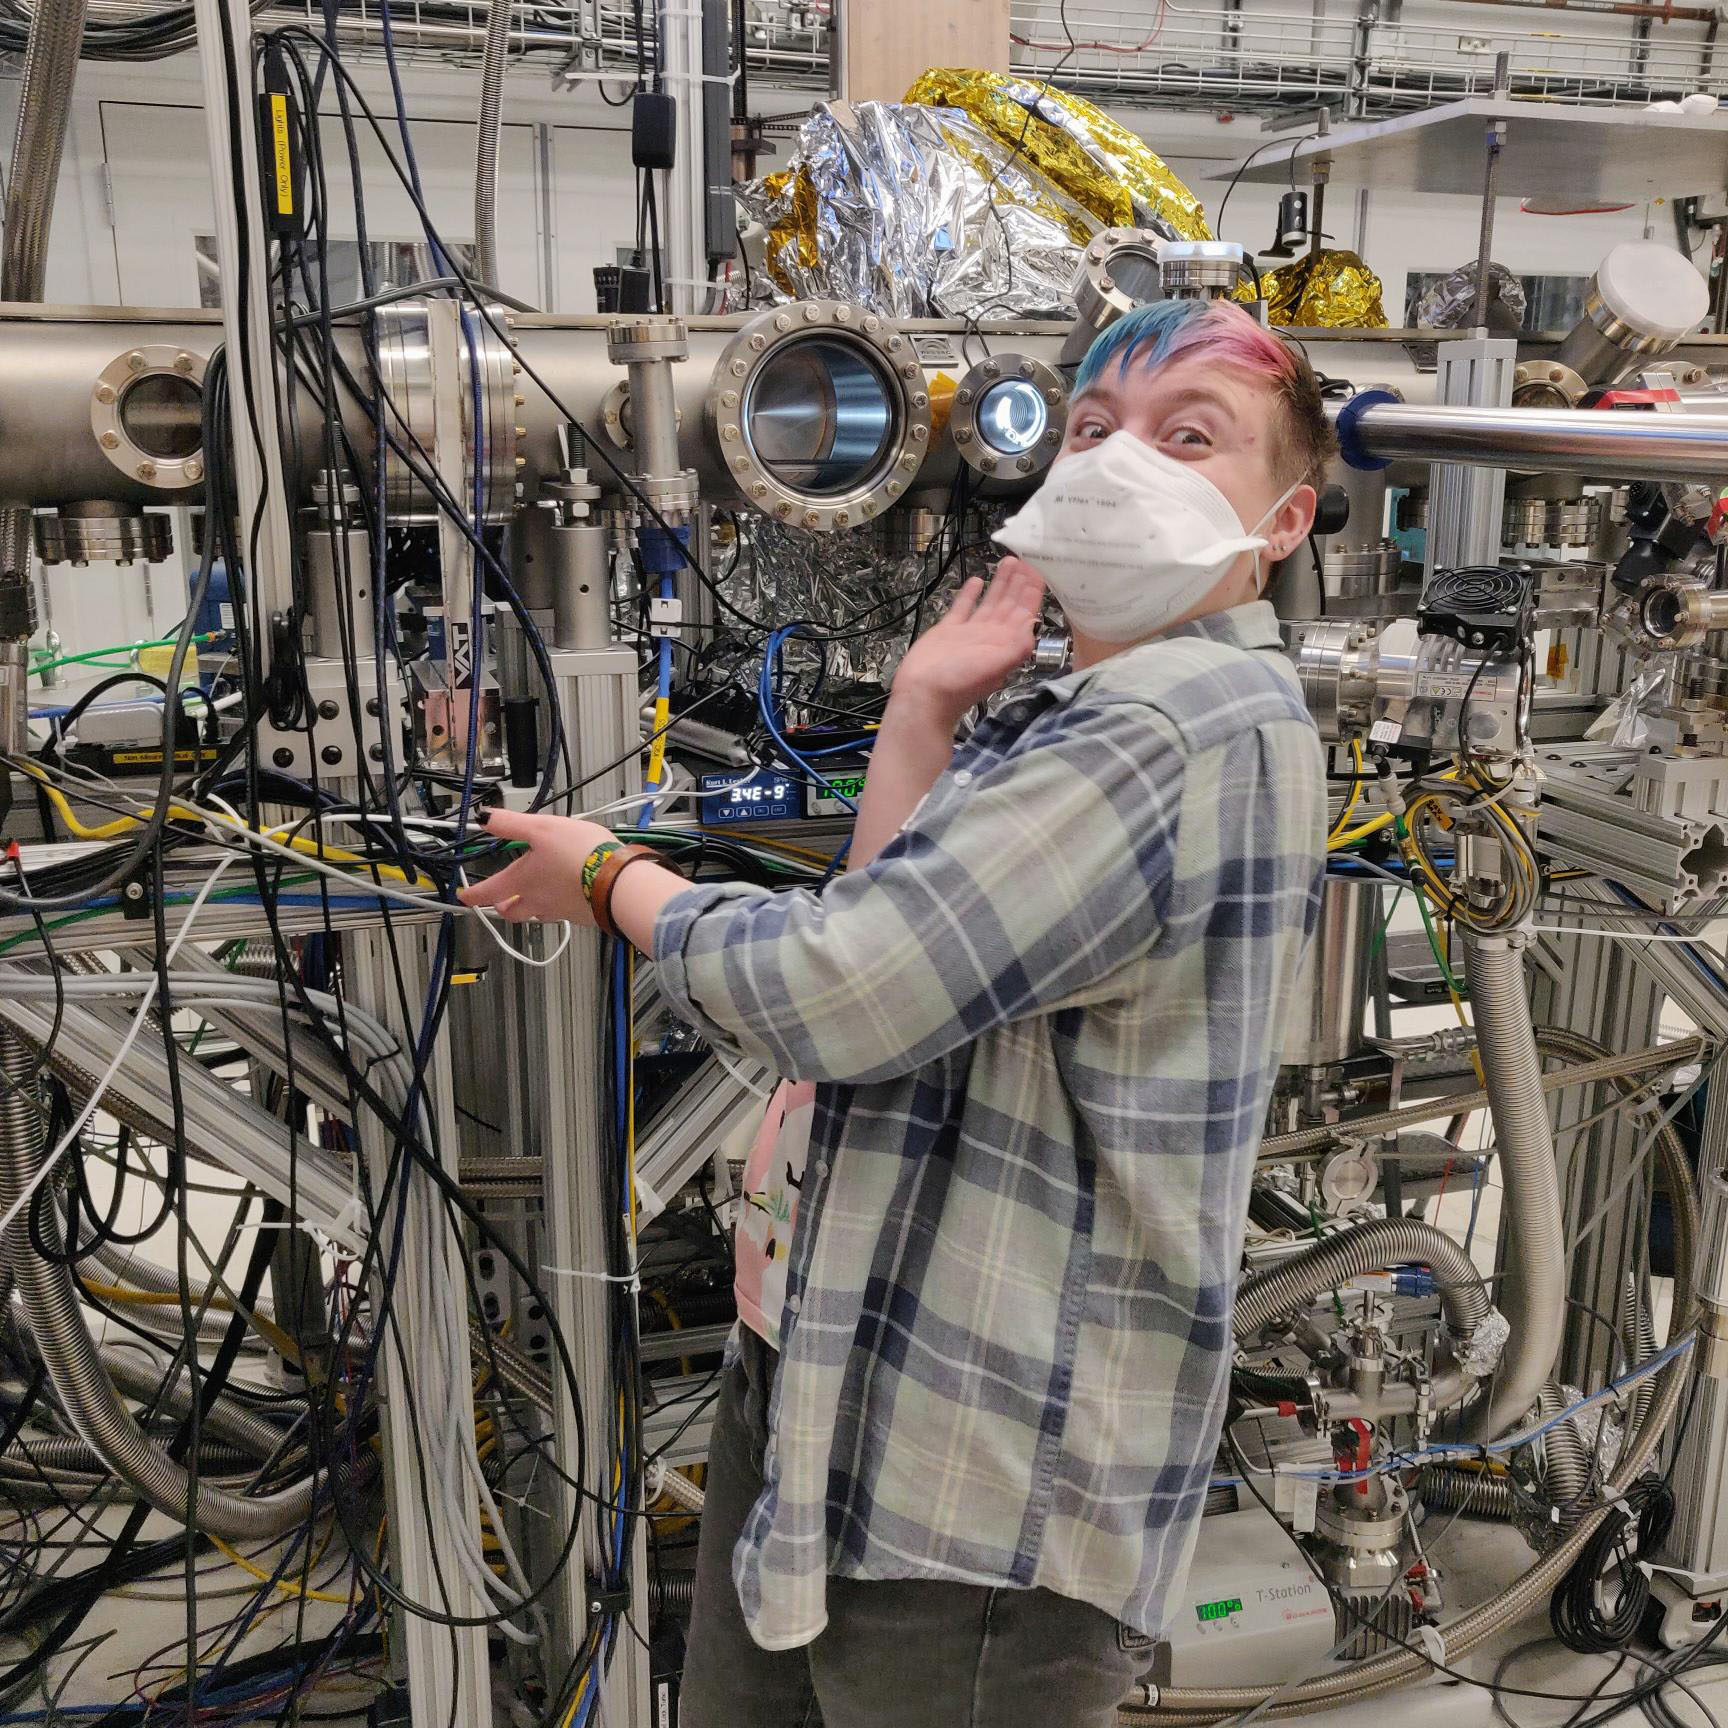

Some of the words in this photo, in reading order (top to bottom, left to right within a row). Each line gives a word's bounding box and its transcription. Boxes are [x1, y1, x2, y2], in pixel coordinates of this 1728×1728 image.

[275, 109, 285, 134] Lights
[276, 140, 287, 170] (Power
[279, 174, 289, 197] Only)
[452, 625, 470, 687] VAT
[1256, 1583, 1311, 1603] T-Station
